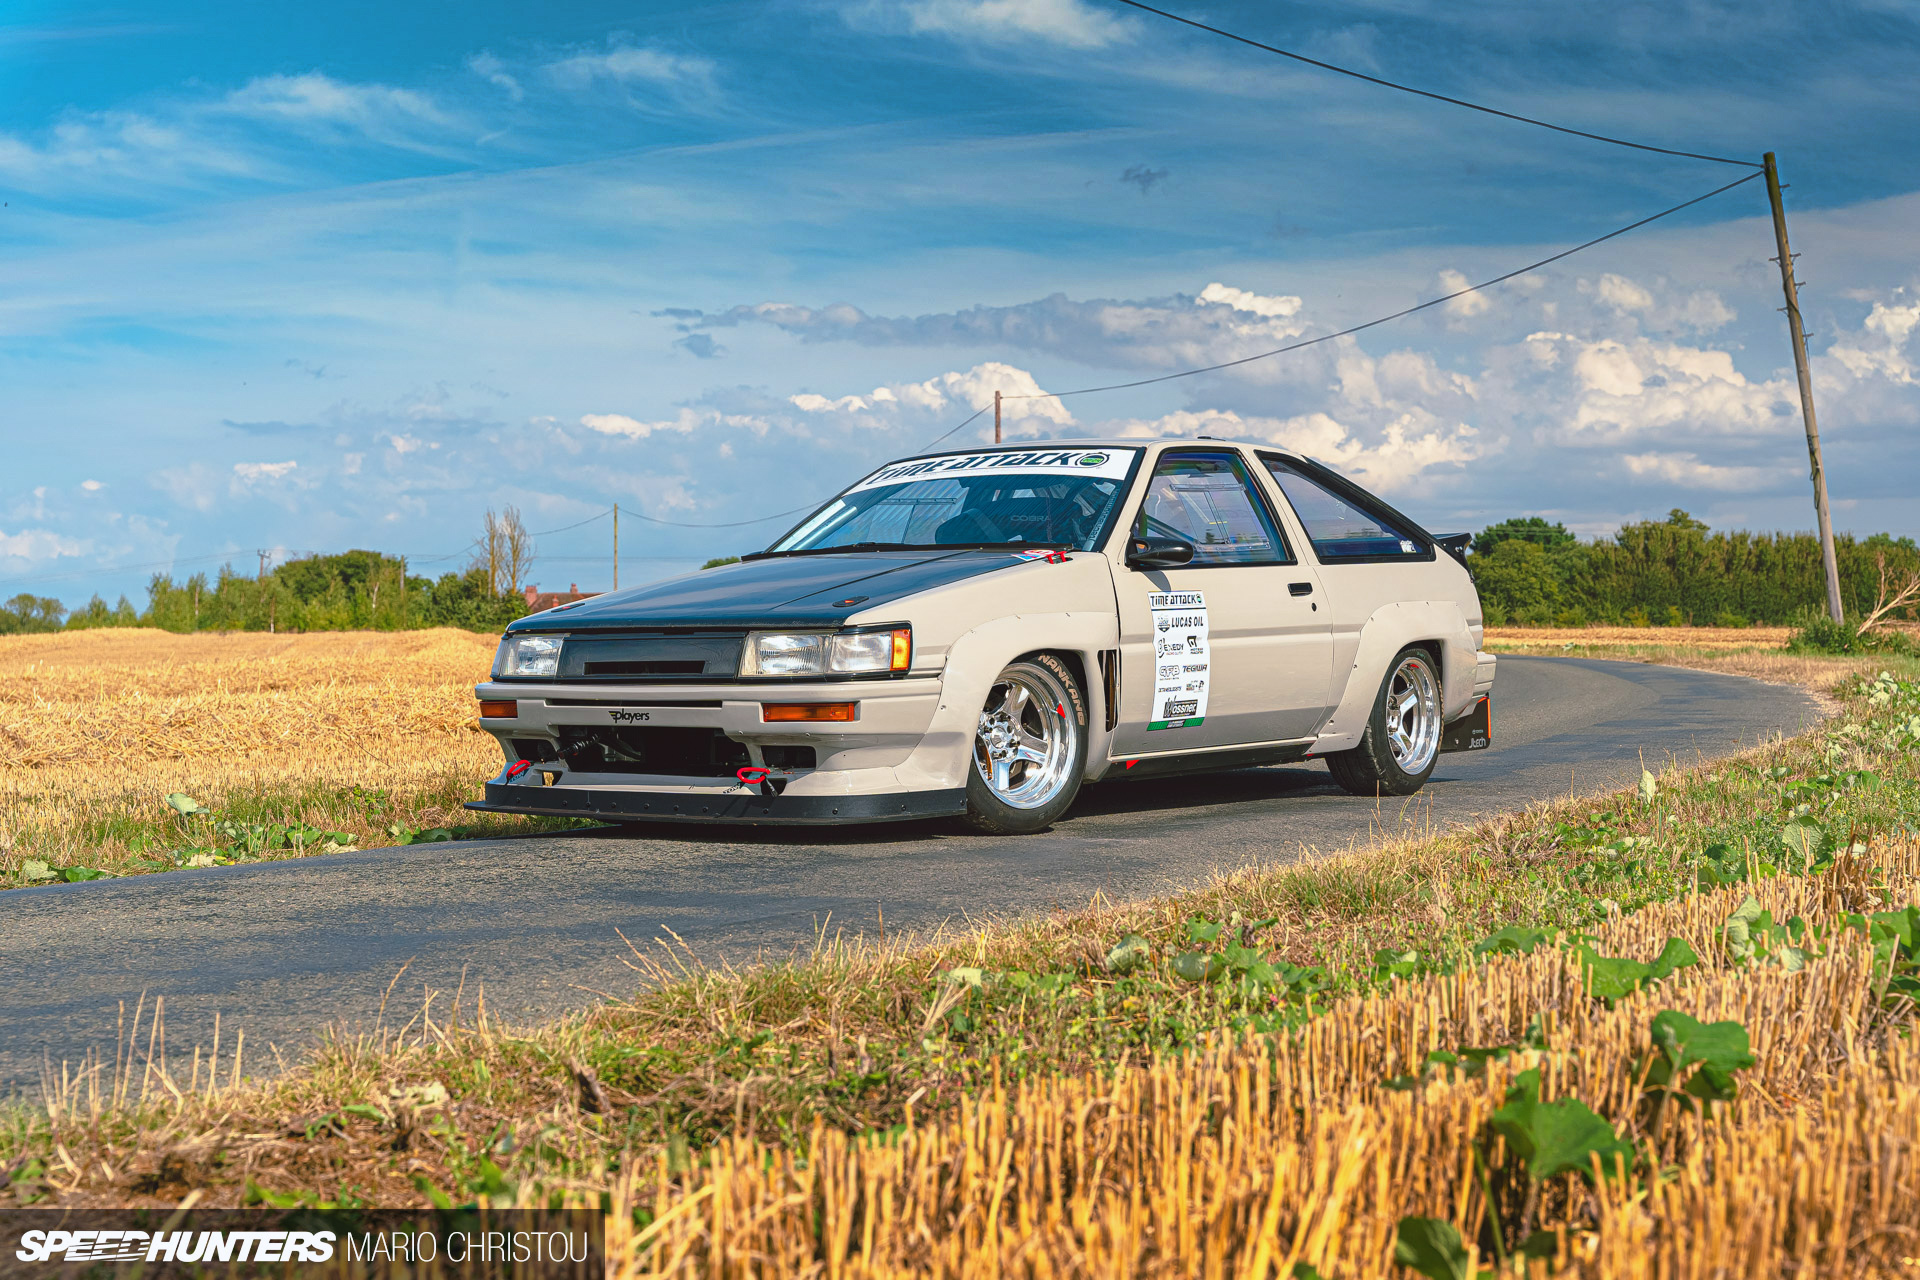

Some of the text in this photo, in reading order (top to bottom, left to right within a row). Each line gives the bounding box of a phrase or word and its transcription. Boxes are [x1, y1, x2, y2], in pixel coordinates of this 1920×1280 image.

[1171, 616, 1193, 628] LUCAS
[1193, 616, 1204, 627] OIL
[1163, 643, 1184, 652] EXEDY
[1182, 664, 1208, 673] TEGIWA
[1037, 654, 1085, 725] NANKANG
